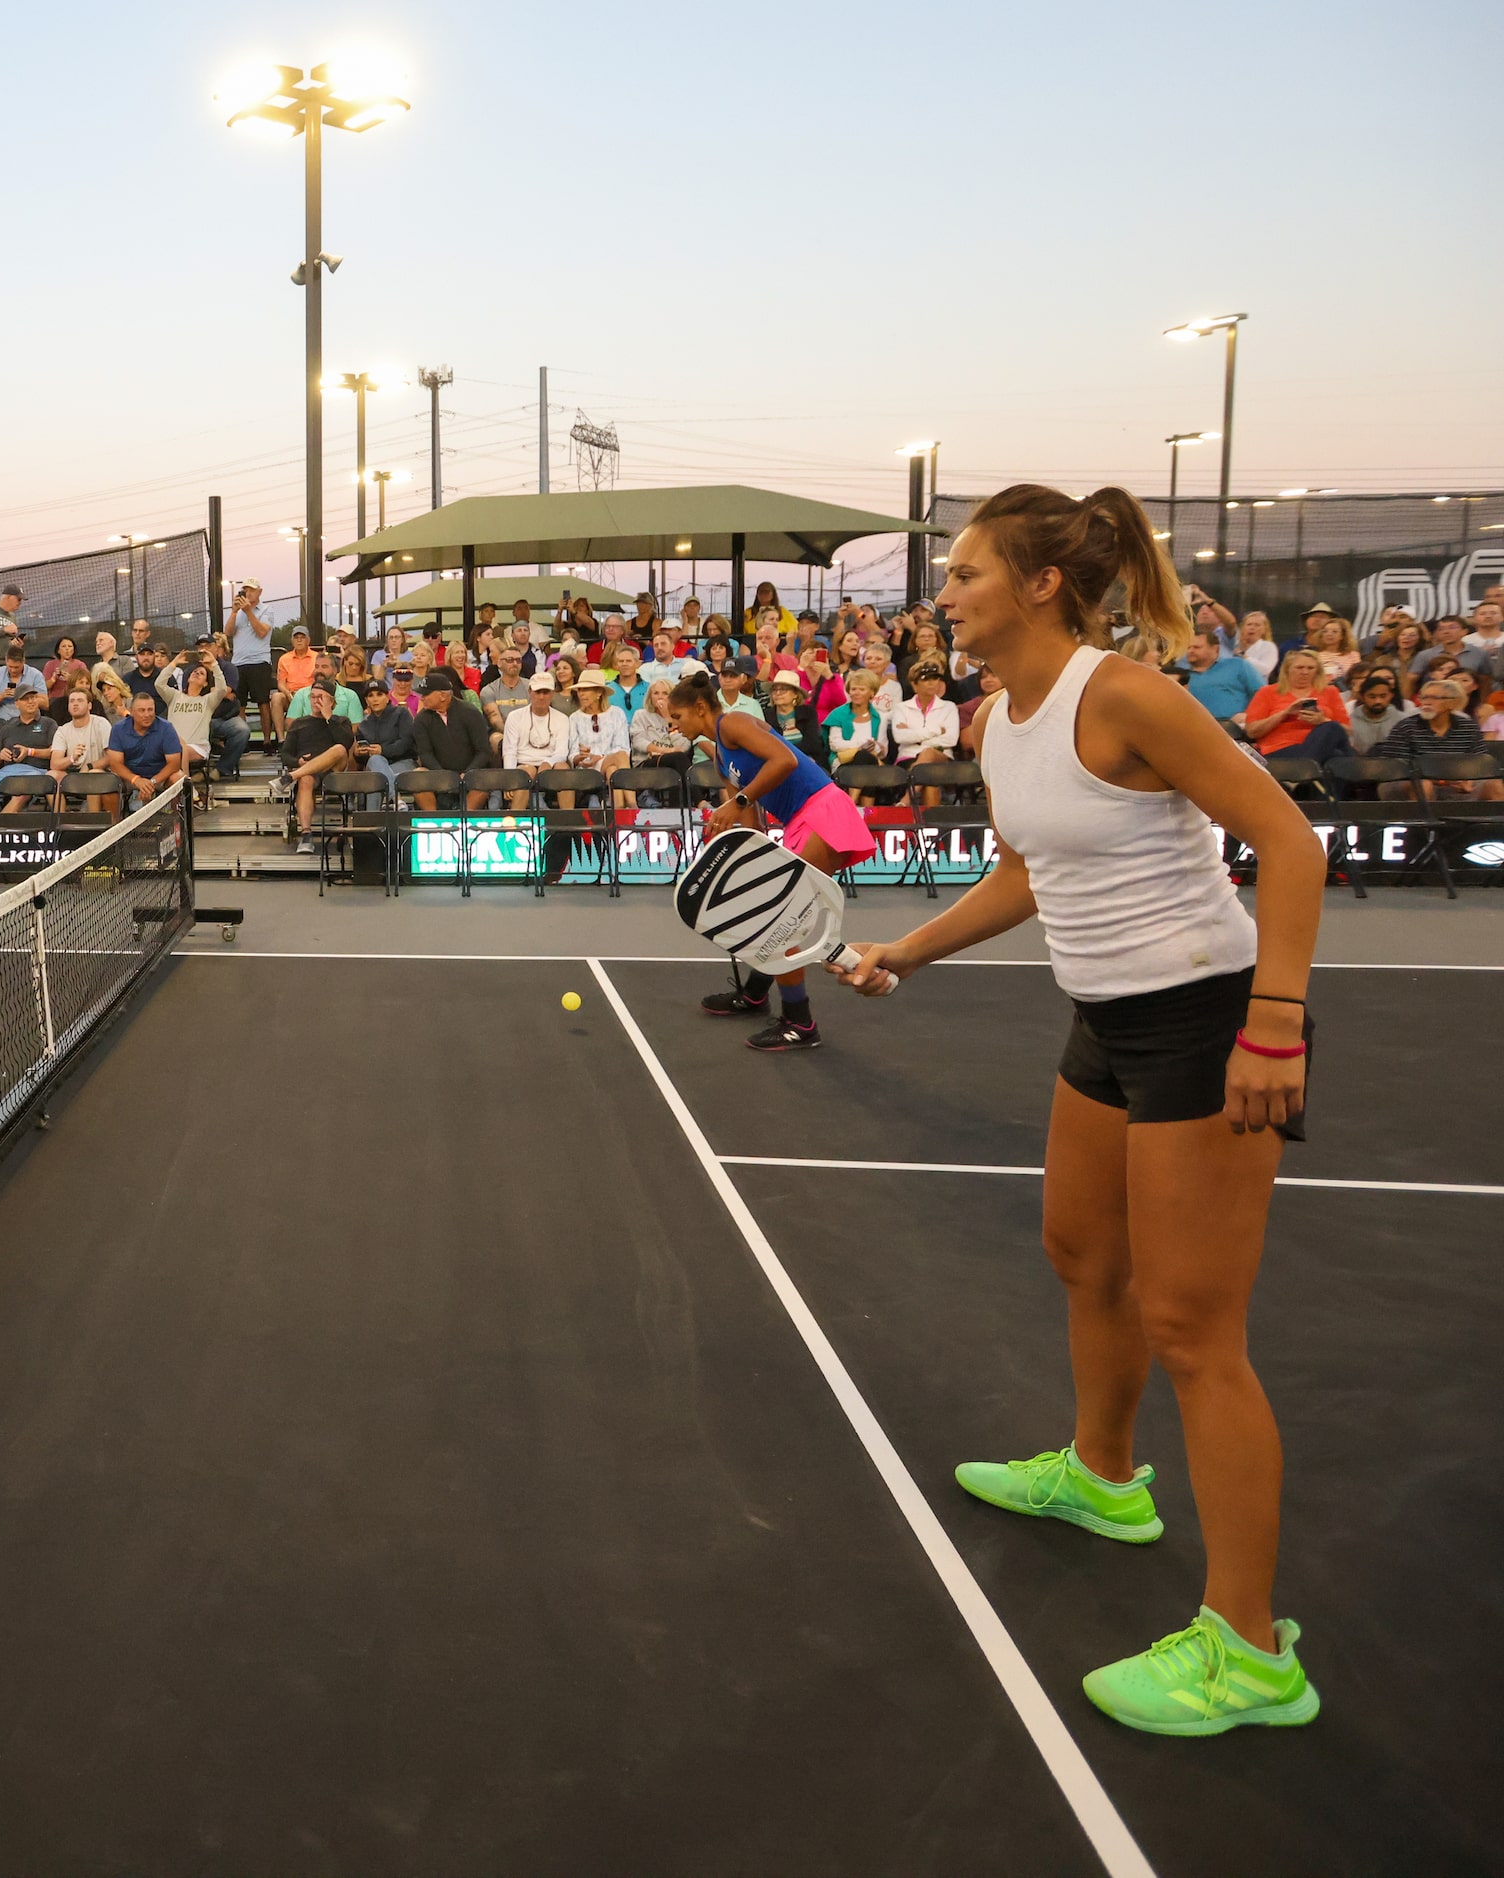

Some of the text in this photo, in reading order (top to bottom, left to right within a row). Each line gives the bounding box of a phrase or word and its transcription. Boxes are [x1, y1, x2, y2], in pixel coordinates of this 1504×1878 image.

[174, 702, 203, 713] BAYLOR
[37, 831, 55, 843] BY
[698, 846, 729, 884] SELKIRK
